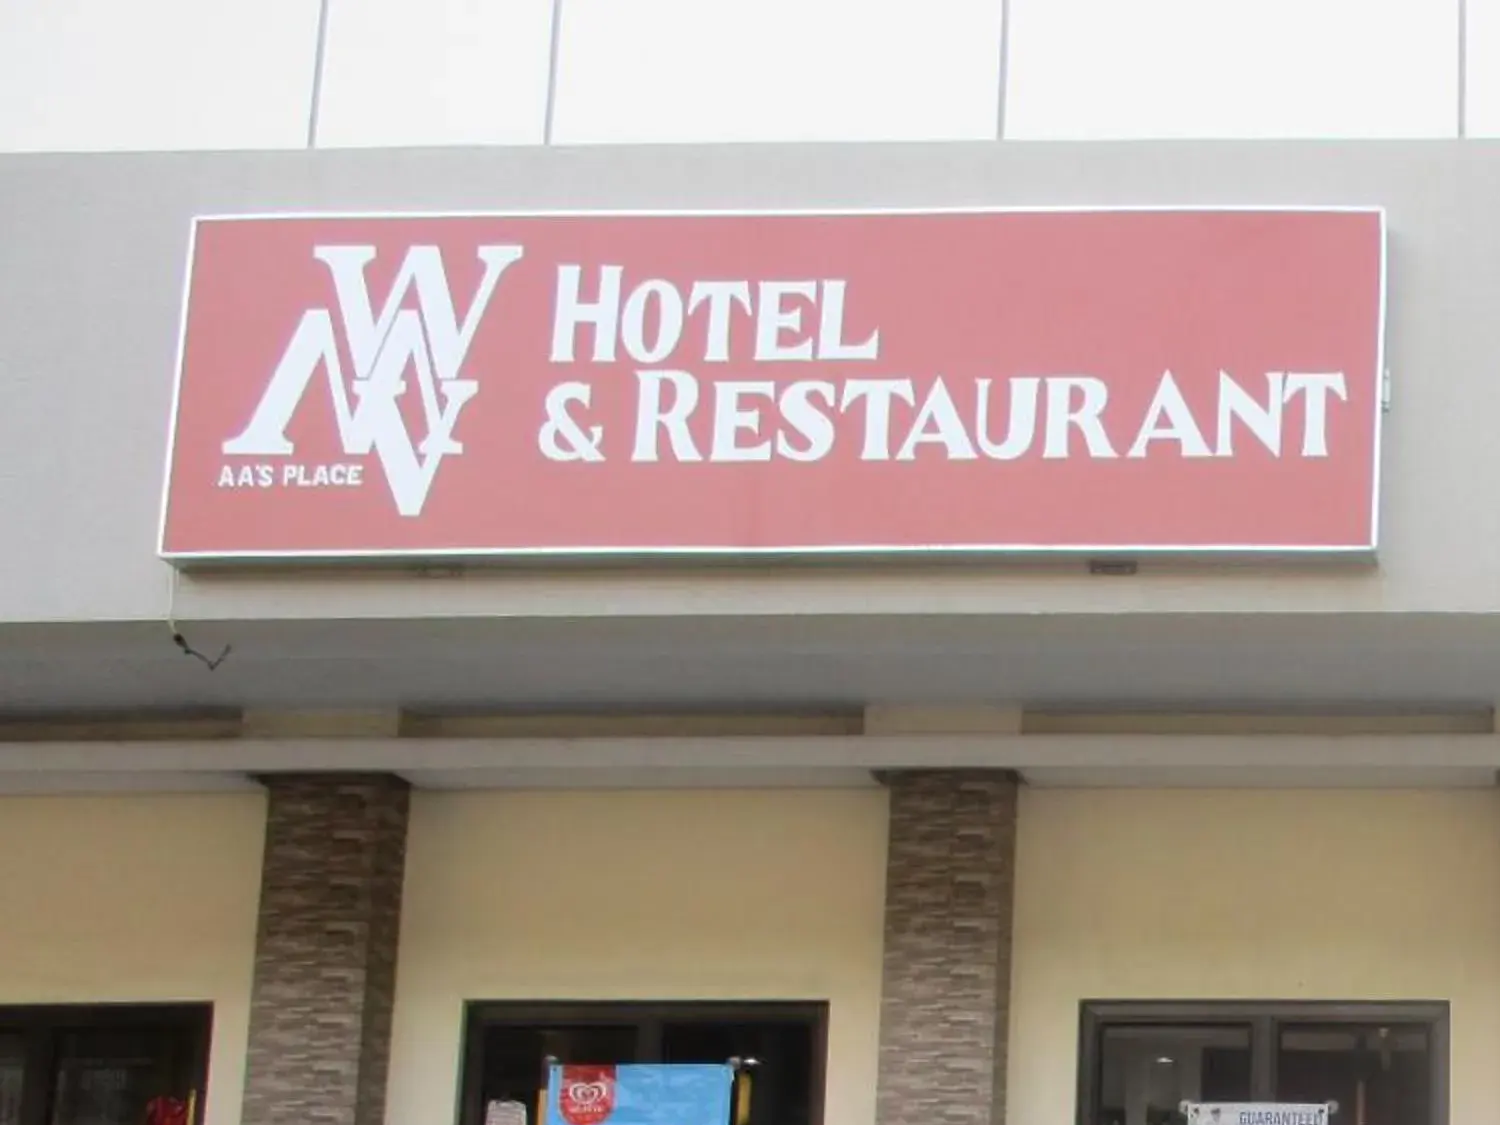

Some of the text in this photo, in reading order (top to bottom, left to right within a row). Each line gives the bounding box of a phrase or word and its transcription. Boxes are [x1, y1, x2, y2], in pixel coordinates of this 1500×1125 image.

[549, 264, 880, 364] HOTEL
[538, 368, 1346, 464] & RESTAURANT
[218, 464, 363, 487] AA'S PLACE
[1240, 1111, 1322, 1125] GUARANTEED
